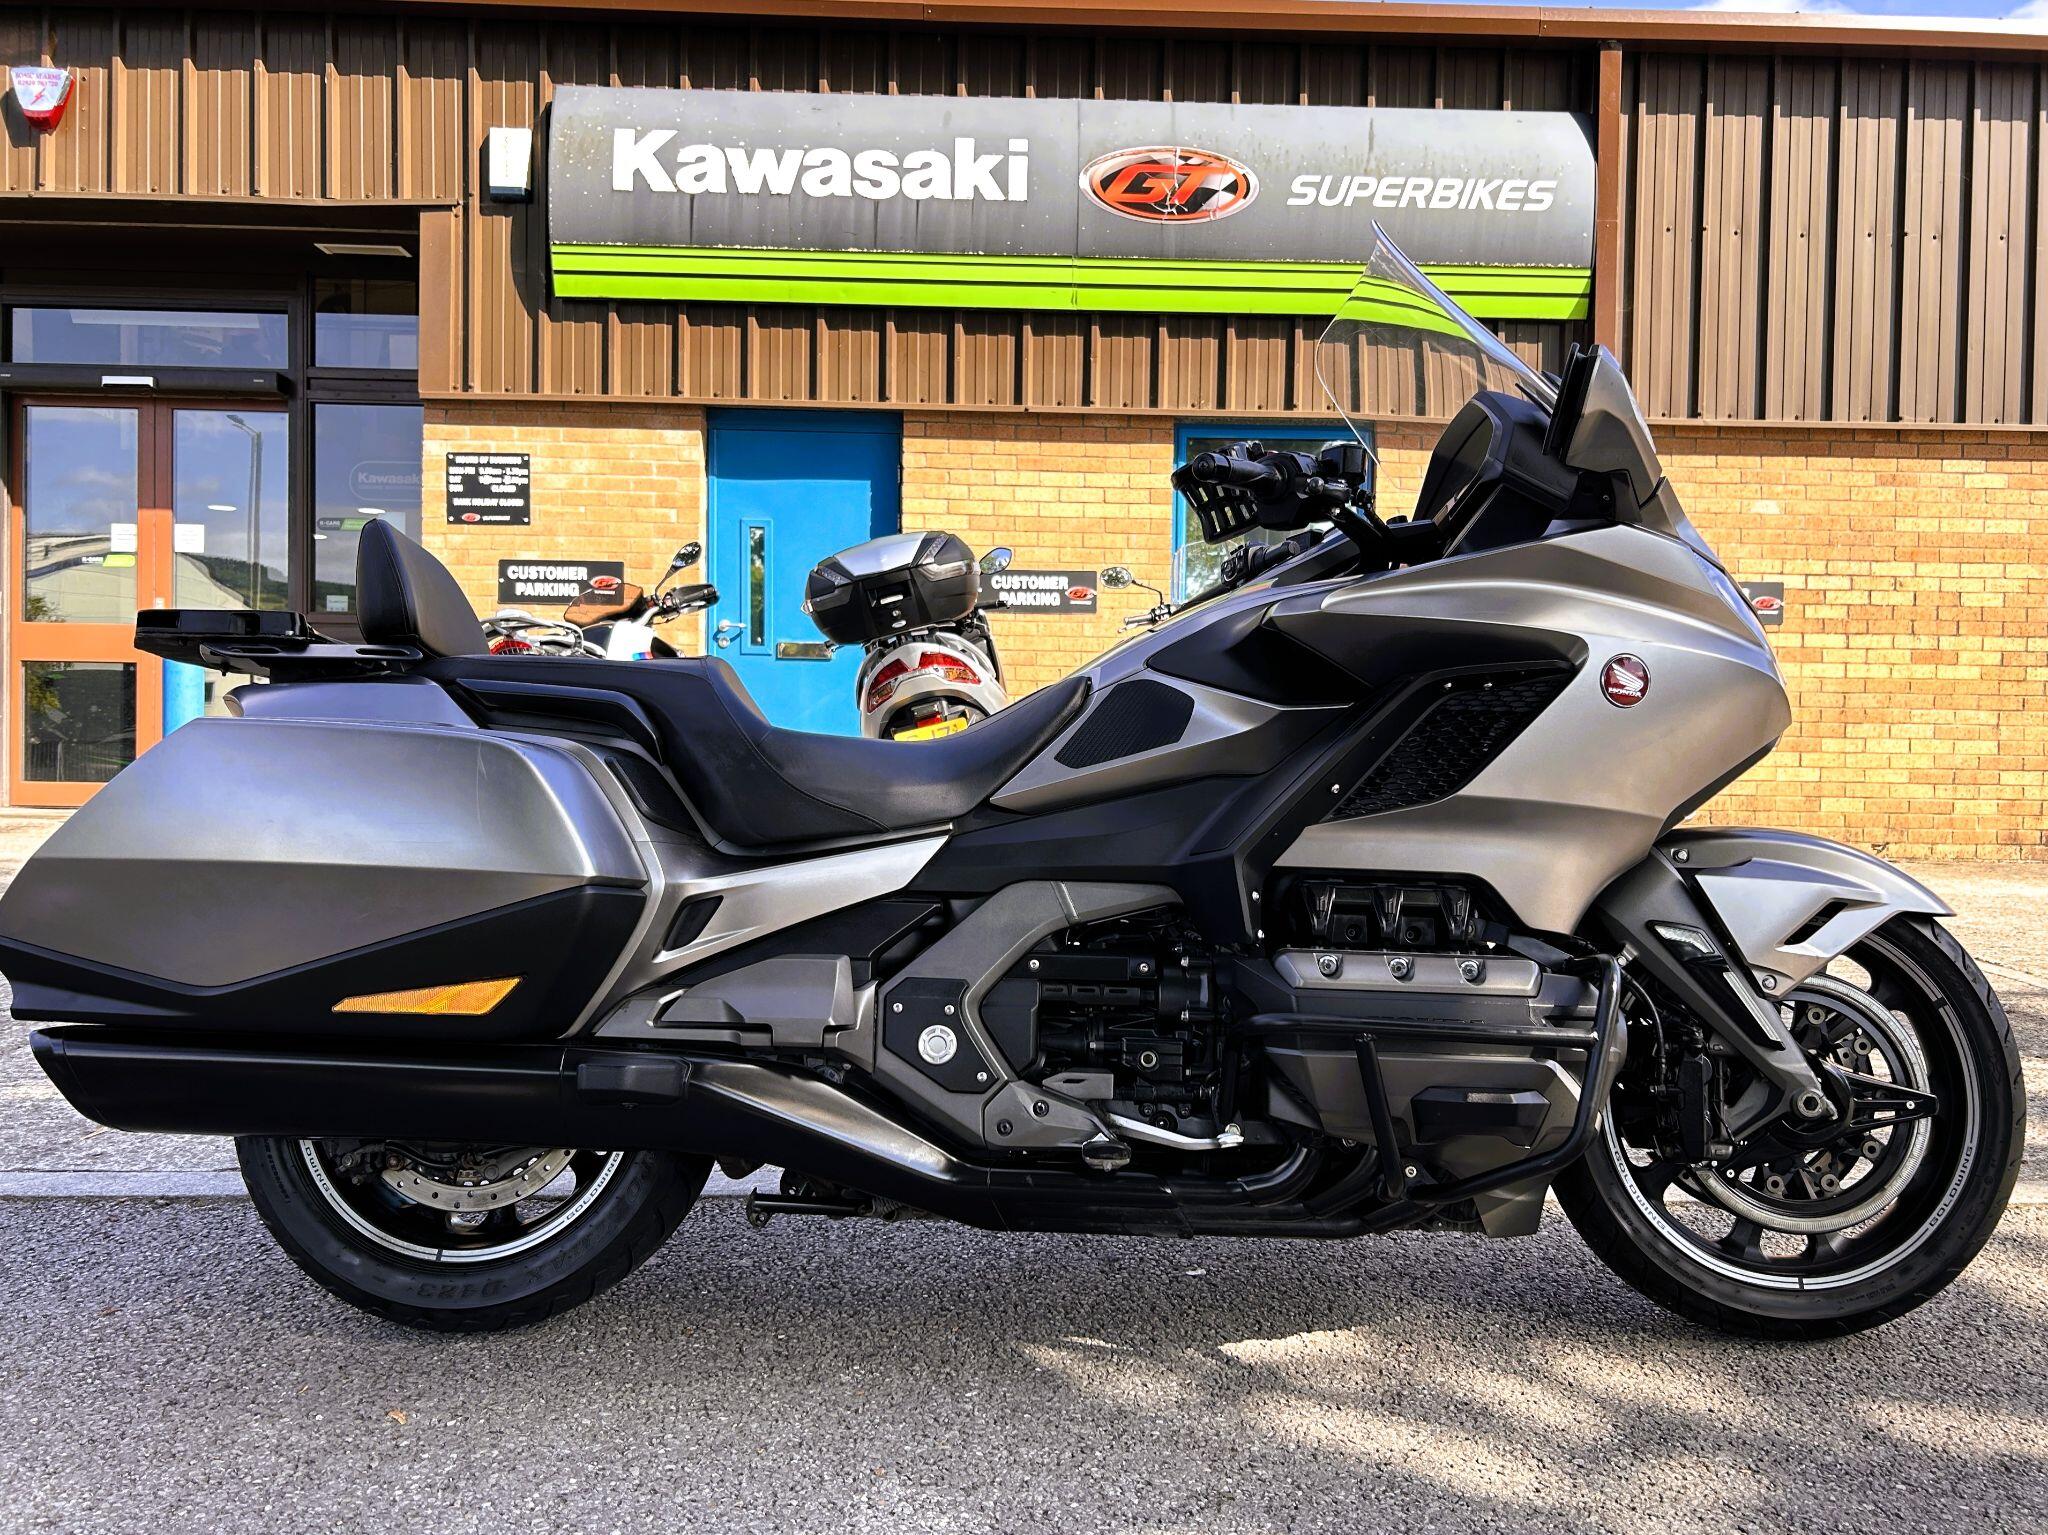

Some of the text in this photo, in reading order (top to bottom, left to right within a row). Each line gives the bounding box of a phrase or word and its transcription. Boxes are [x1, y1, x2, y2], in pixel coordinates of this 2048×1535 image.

[612, 128, 1028, 201] Kawasaki
[1104, 164, 1558, 212] GT SUPERBIKES
[358, 472, 419, 484] Kawasak
[507, 565, 588, 581] CUSTOMER
[991, 575, 1068, 590] CUSTOMER
[515, 582, 580, 597] PARKING
[999, 591, 1061, 606] PARKING
[1608, 687, 1642, 698] HONDA
[303, 1140, 331, 1192] DWING
[566, 1152, 621, 1220] GOLDWING
[1615, 1151, 1667, 1230] GOLDWING
[1929, 1146, 1973, 1227] GOLDWING
